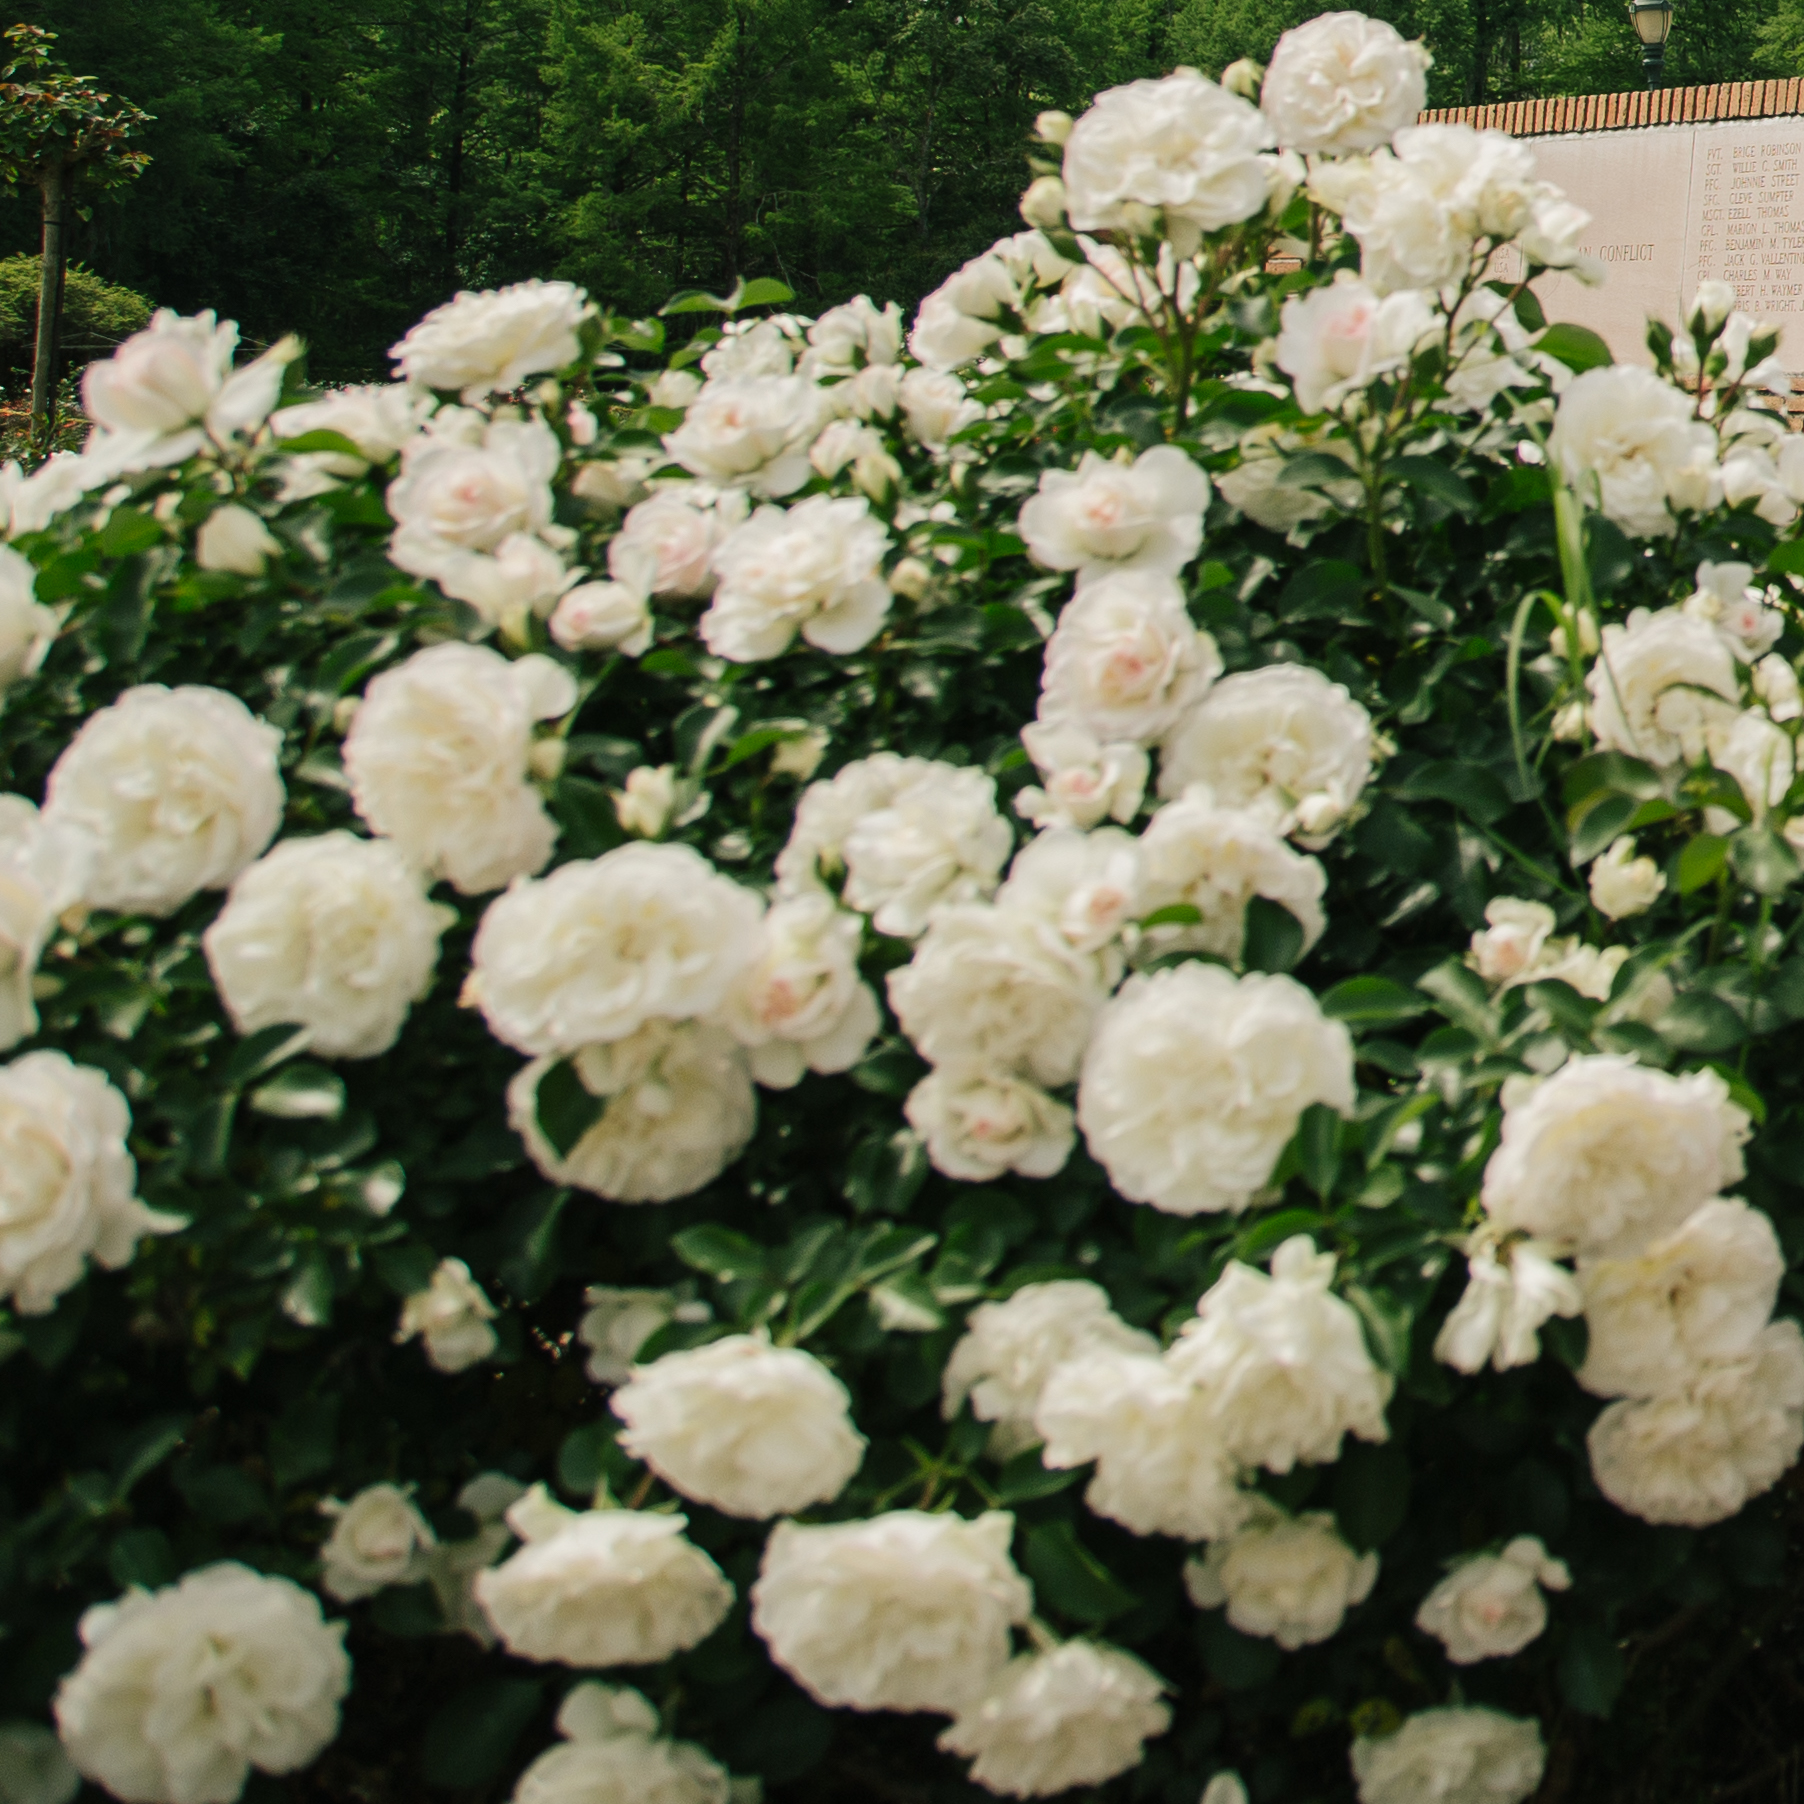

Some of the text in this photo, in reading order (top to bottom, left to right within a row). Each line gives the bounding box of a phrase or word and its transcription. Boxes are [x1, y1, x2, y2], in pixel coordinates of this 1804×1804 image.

[1733, 146, 1755, 158] BRICE
[1761, 142, 1801, 157] ROBINSON
[1706, 164, 1722, 175] SGT.
[1733, 162, 1756, 173] WILLIE
[1773, 159, 1797, 171] SMITH
[1704, 179, 1720, 191] PFC.
[1730, 176, 1765, 189] JOHNNIE
[1771, 174, 1800, 187] STREET
[1703, 194, 1719, 206] SFC.
[1729, 192, 1753, 204] CLEVE
[1758, 191, 1794, 204] SUMPTER
[1702, 209, 1724, 221] MSGT.
[1728, 208, 1751, 220] EZELL
[1757, 206, 1789, 218] THOMAS
[1702, 225, 1718, 236] CPL.
[1727, 223, 1757, 235] MARION
[1700, 240, 1716, 251] PFC.
[1726, 238, 1764, 251] BENJAMIN
[1600, 245, 1654, 262] CONFLICT
[1699, 255, 1715, 267] PFC.
[1724, 254, 1745, 266] JACK
[1724, 269, 1757, 281] CHARLES
[1776, 268, 1792, 280] WAY
[1772, 284, 1802, 296] WAYMER
